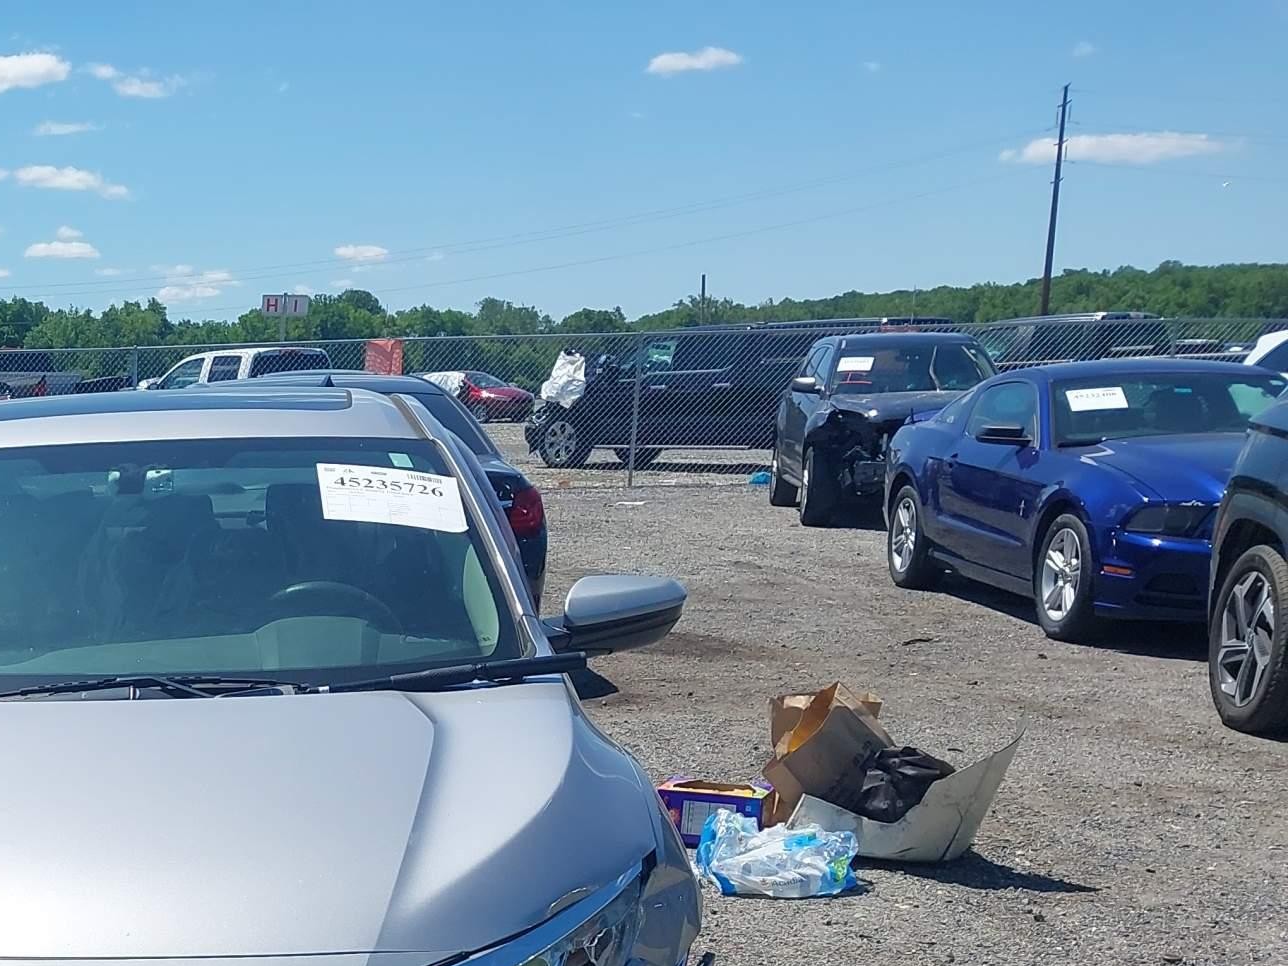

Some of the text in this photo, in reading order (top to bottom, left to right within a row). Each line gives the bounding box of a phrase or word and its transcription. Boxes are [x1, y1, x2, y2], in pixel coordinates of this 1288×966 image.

[266, 297, 298, 312] H I
[333, 476, 444, 497] 45235726
